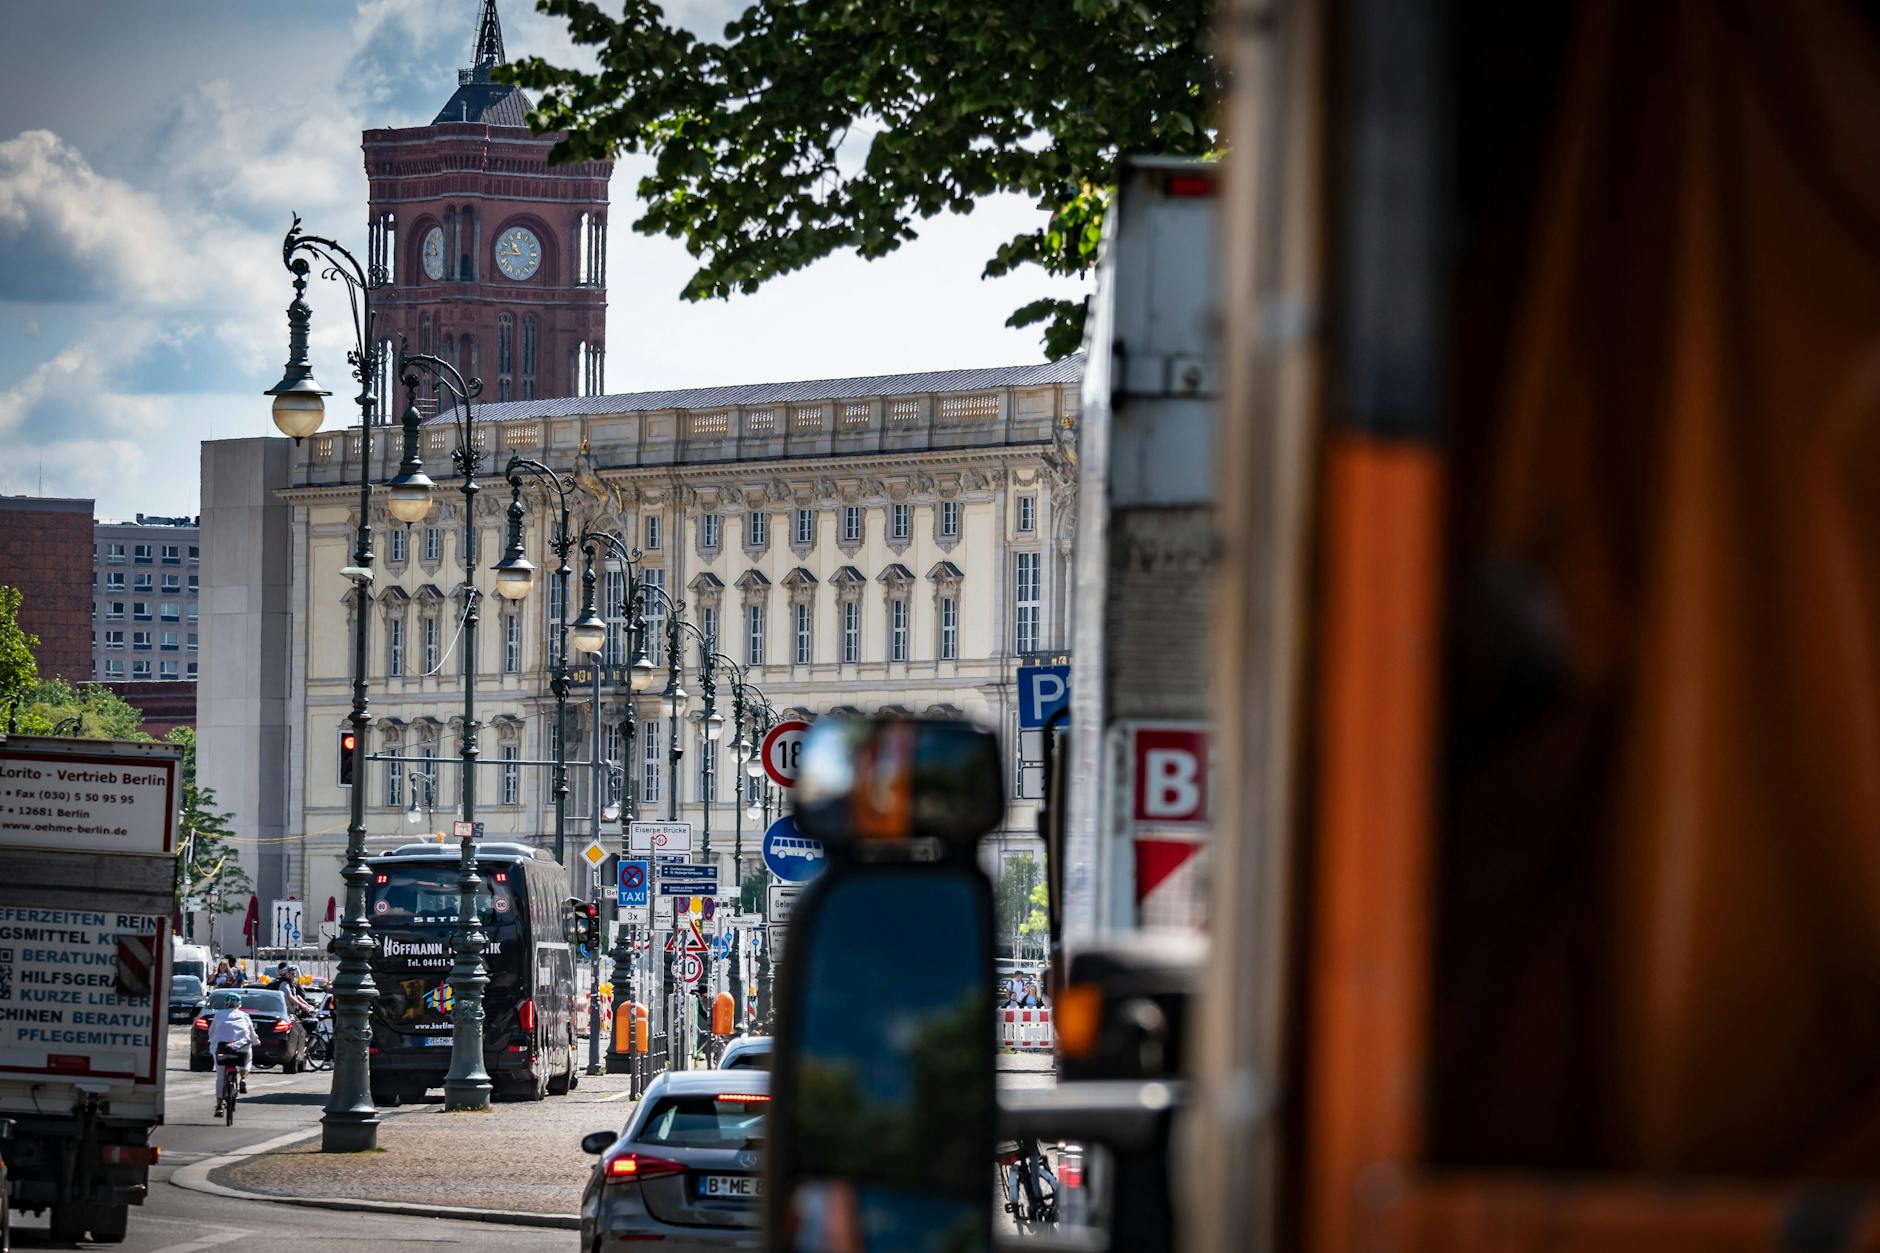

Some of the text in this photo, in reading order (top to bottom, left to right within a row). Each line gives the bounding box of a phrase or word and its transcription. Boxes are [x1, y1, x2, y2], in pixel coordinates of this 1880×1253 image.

[1032, 674, 1066, 721] P
[0, 767, 41, 780] Lorito
[57, 769, 118, 784] Vertrieb
[122, 773, 166, 786] Berlin
[1144, 750, 1201, 818] B
[15, 789, 135, 805] Fax (030) 5 50 95 95
[19, 807, 90, 819] 12681 Berlin
[2, 822, 128, 837] www.oehme-berlin.de
[663, 826, 687, 834] Brücke
[621, 892, 645, 902] TAXI
[117, 915, 157, 929] REIN
[627, 912, 638, 920] 3x
[0, 927, 91, 945] GSMITTEL
[383, 935, 443, 958] HÖFFMANN
[22, 949, 119, 966] BERATUNG
[407, 959, 421, 967] Tel.
[20, 989, 152, 1007] KURZE LIEFER
[17, 1028, 151, 1047] PFLEGEMITTEL
[708, 1178, 719, 1193] B
[729, 1179, 751, 1195] ME
